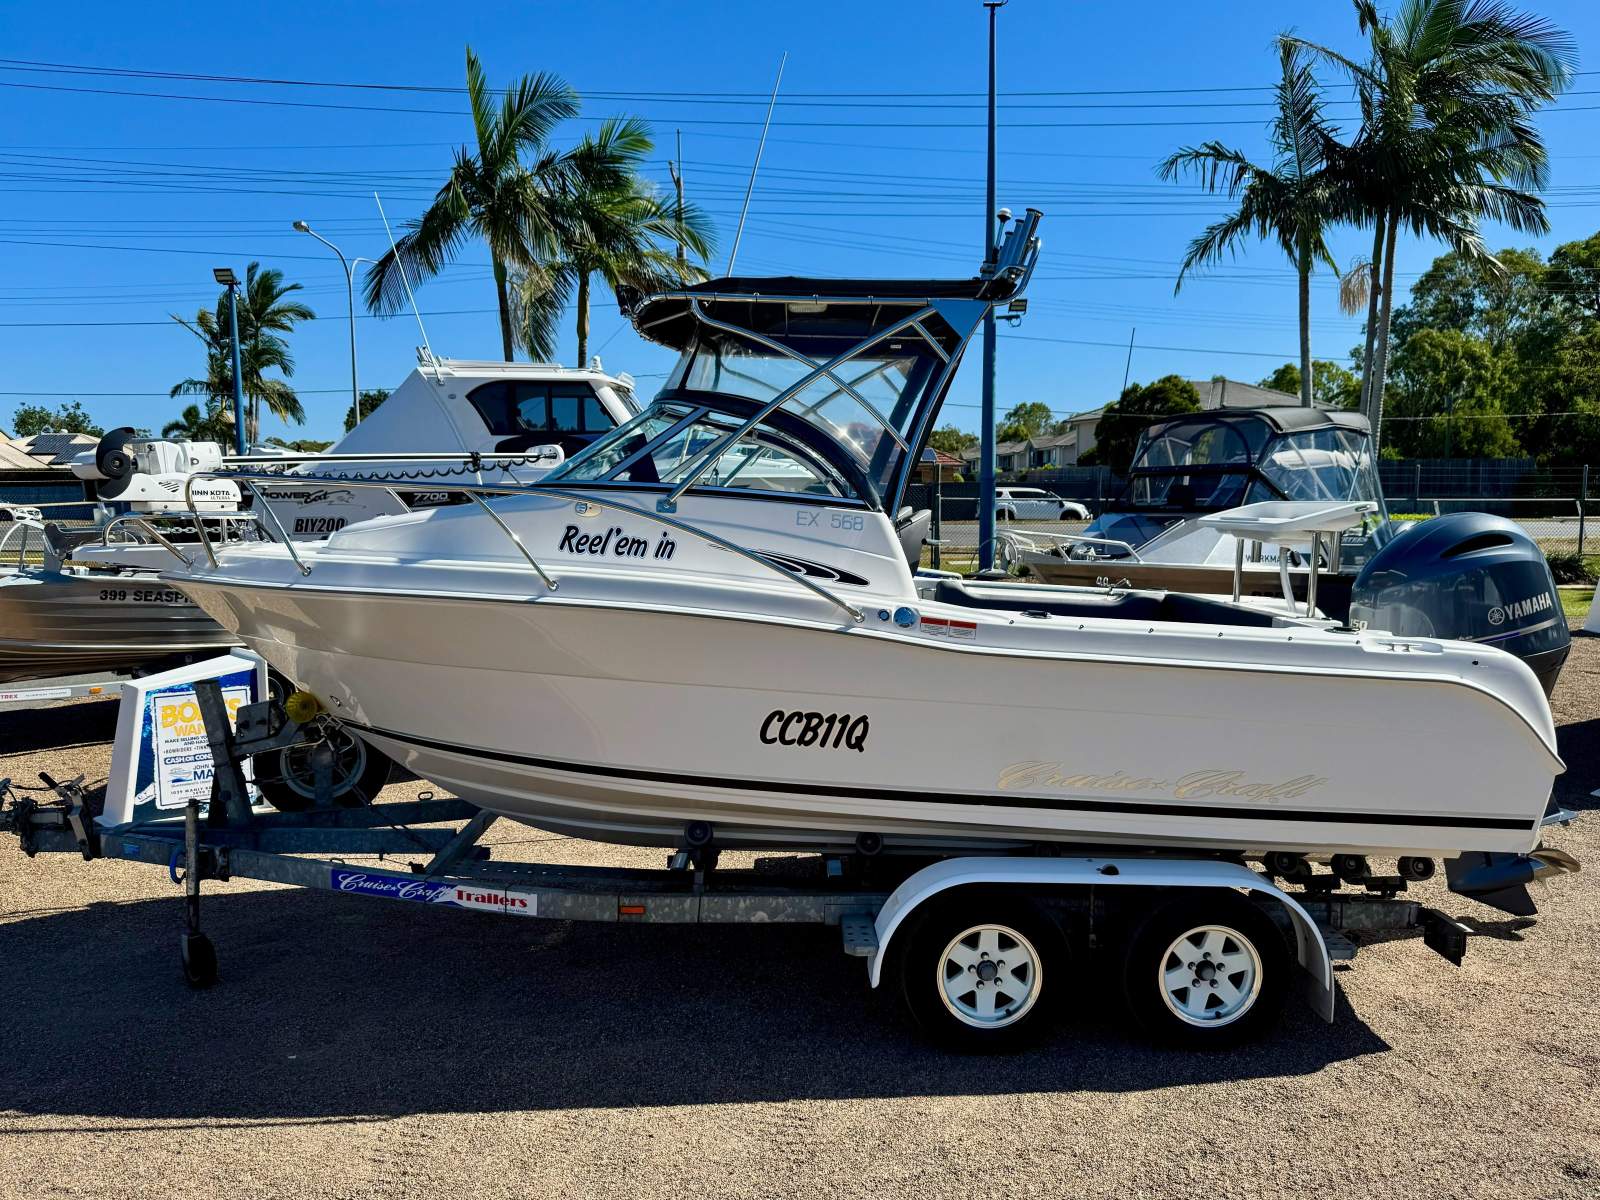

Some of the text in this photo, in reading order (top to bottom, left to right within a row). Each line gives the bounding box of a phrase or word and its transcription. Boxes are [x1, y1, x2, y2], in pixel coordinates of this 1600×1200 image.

[294, 518, 345, 533] BIY200
[796, 511, 864, 532] EX 568
[655, 531, 676, 560] in
[100, 589, 127, 601] 399
[1504, 592, 1553, 621] YAMAHA
[760, 709, 870, 753] CCB11Q
[165, 756, 185, 764] CASH
[997, 760, 1329, 804] Cruise Craft
[338, 873, 452, 902] Cruise Craft
[456, 890, 528, 908] Trailers
